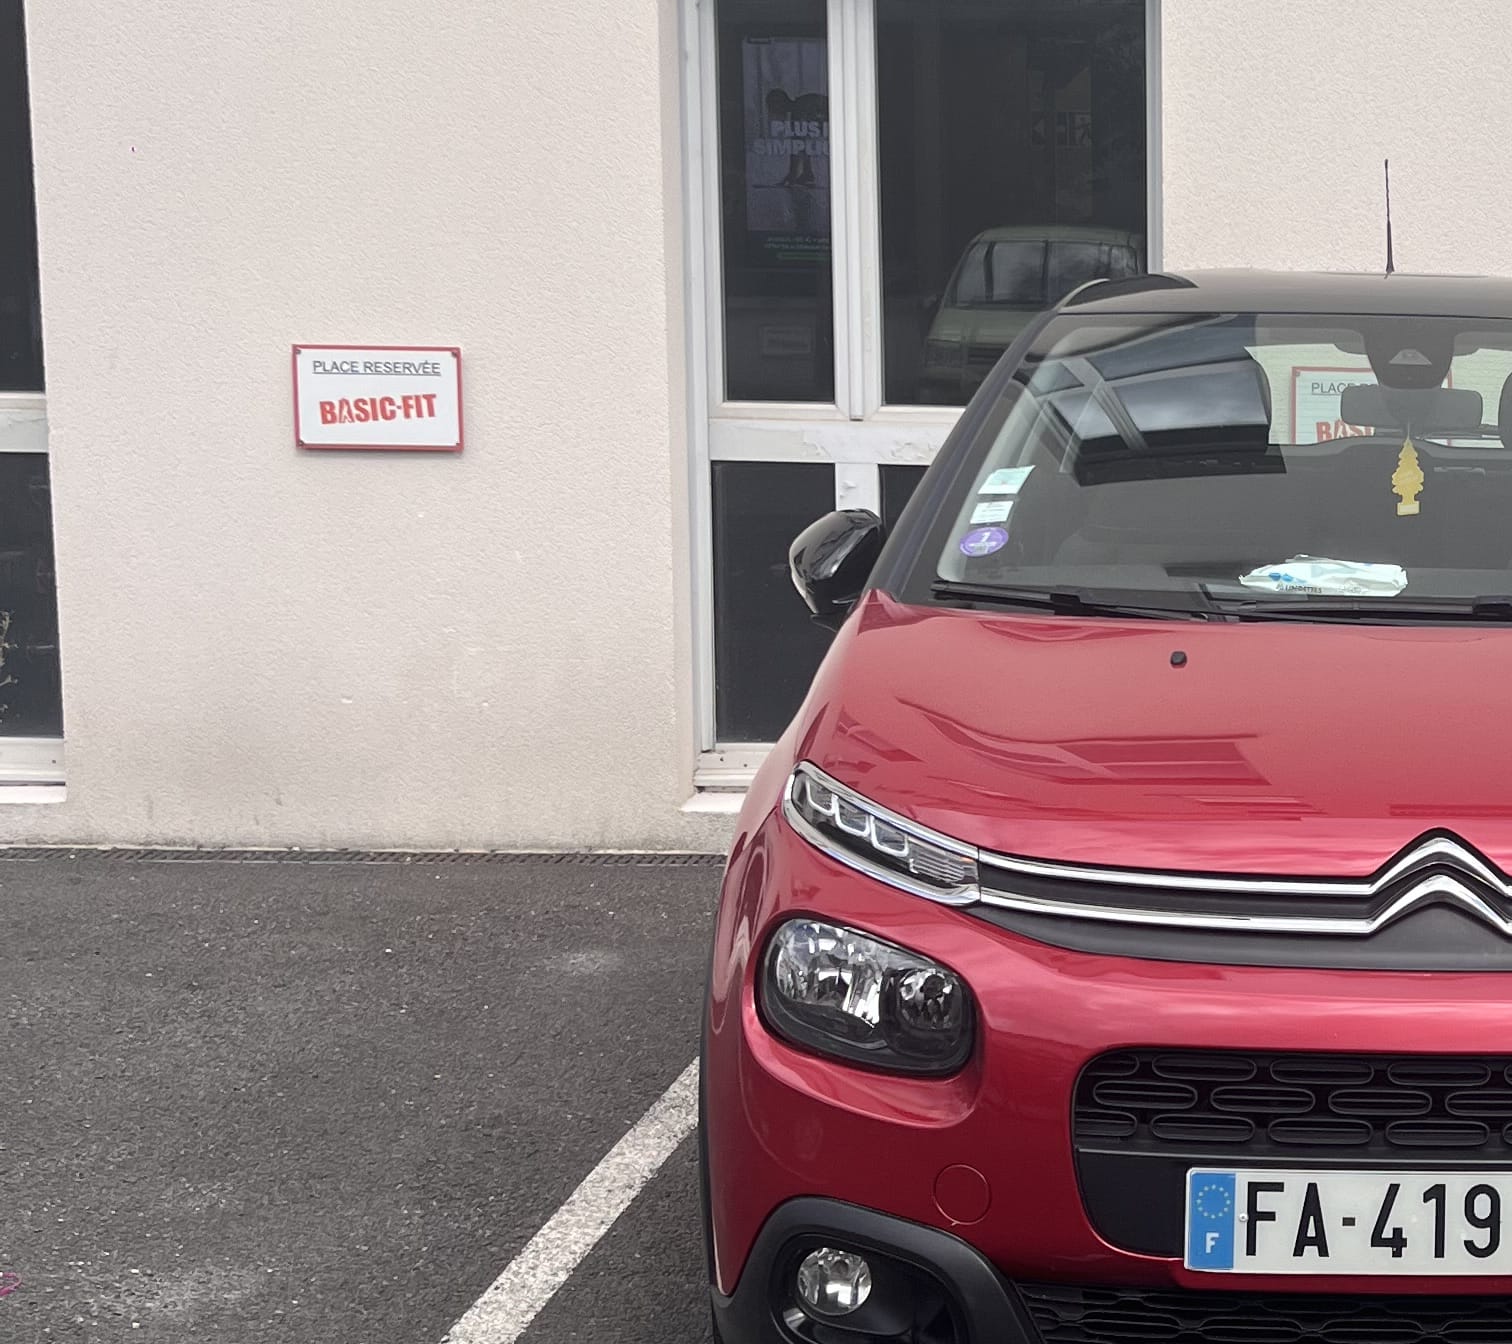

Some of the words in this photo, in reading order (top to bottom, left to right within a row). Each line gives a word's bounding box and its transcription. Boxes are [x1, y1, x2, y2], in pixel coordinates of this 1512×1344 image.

[771, 120, 820, 137] PLUS
[312, 360, 359, 373] PLACE
[1311, 382, 1356, 394] PLAC
[1205, 1233, 1219, 1254] F
